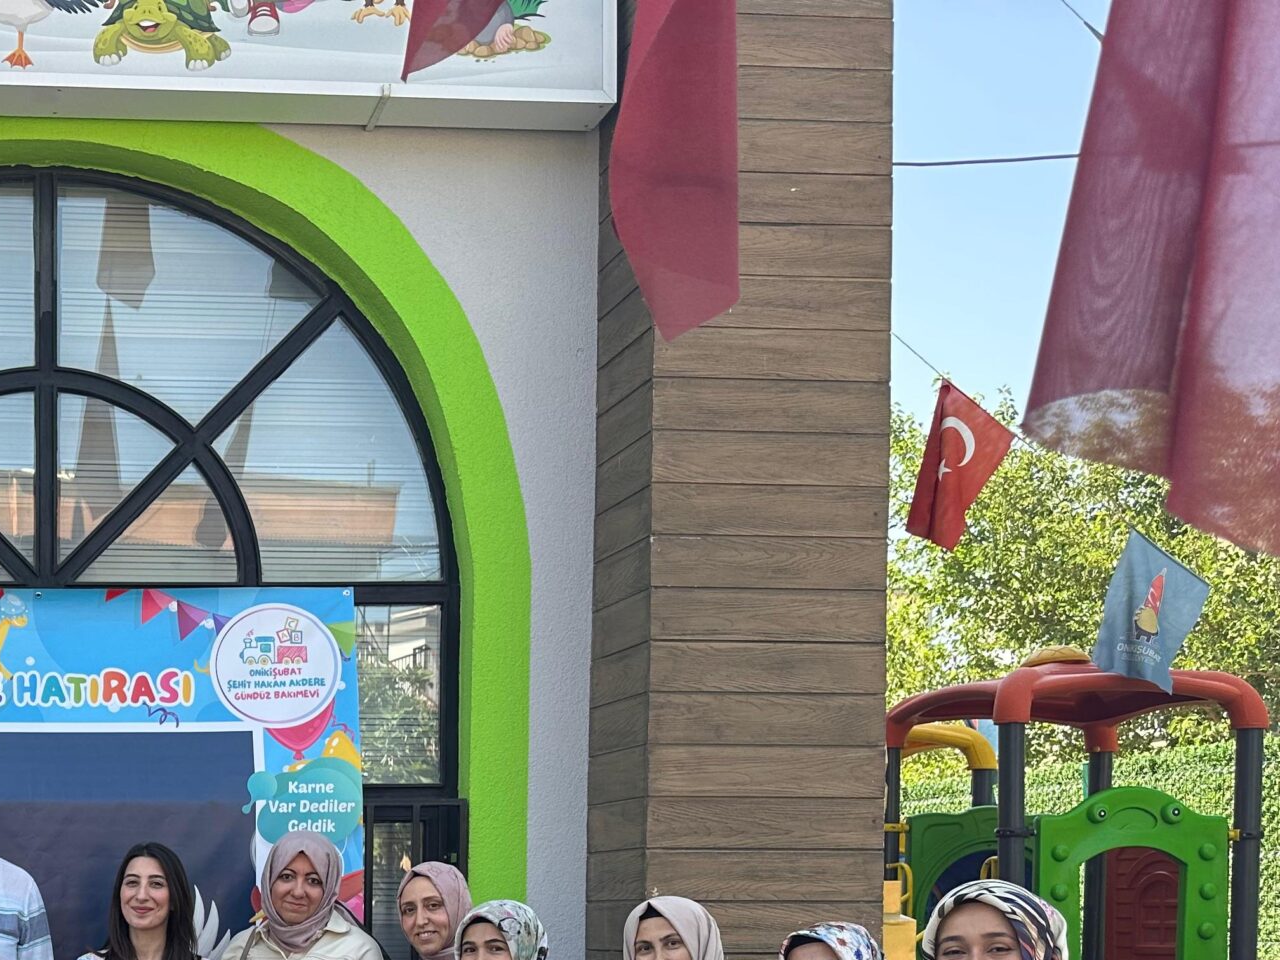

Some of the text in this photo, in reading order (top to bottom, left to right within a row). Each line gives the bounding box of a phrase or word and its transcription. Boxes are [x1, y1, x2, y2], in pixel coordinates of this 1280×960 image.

[12, 667, 196, 707] HATIRASI
[227, 677, 326, 692] ŞEHİT HAKAN AKDERE
[234, 690, 271, 701] GÜNDÜZ
[288, 781, 335, 794] Karne
[268, 799, 356, 813] Var Dediler
[288, 819, 336, 833] Geldik
